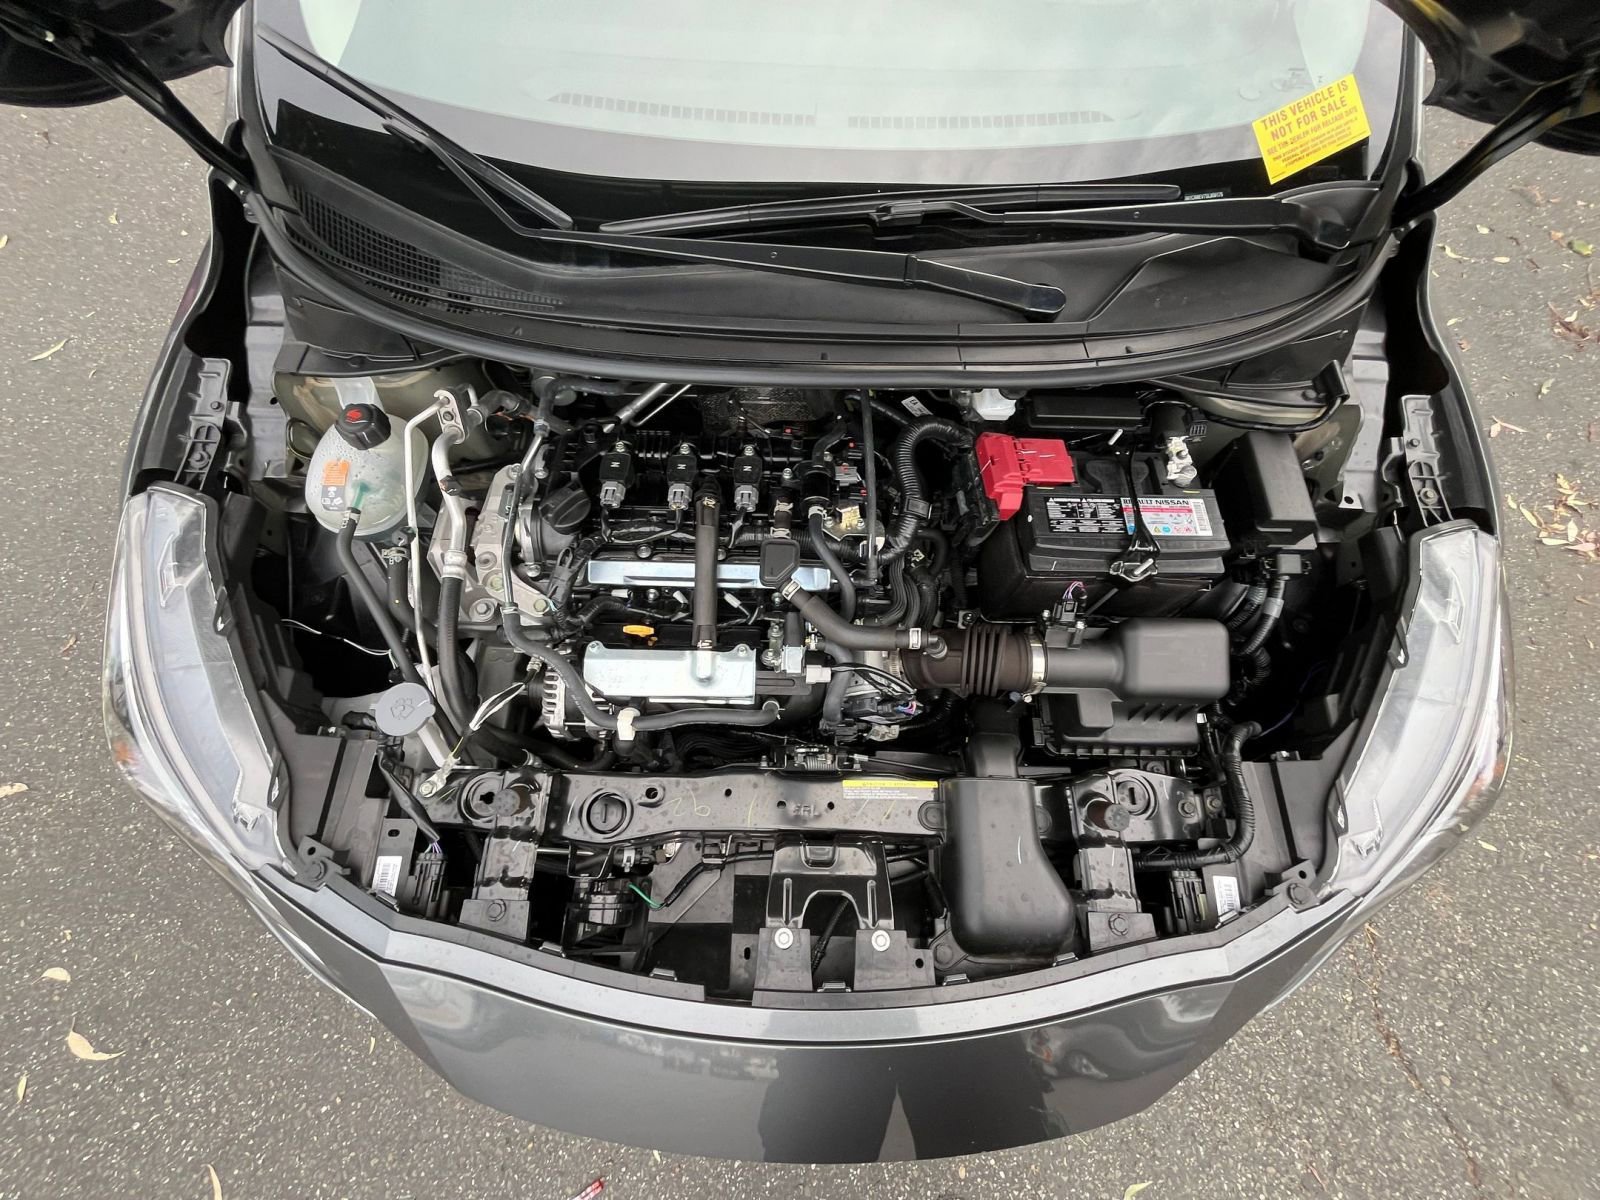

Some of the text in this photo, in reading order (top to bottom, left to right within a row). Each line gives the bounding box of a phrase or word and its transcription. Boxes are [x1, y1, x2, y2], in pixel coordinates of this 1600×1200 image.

[1261, 79, 1349, 130] THIS VEHICLE IS
[1270, 122, 1294, 141] NOT
[1296, 110, 1317, 129] FOR
[1320, 96, 1347, 117] SALE
